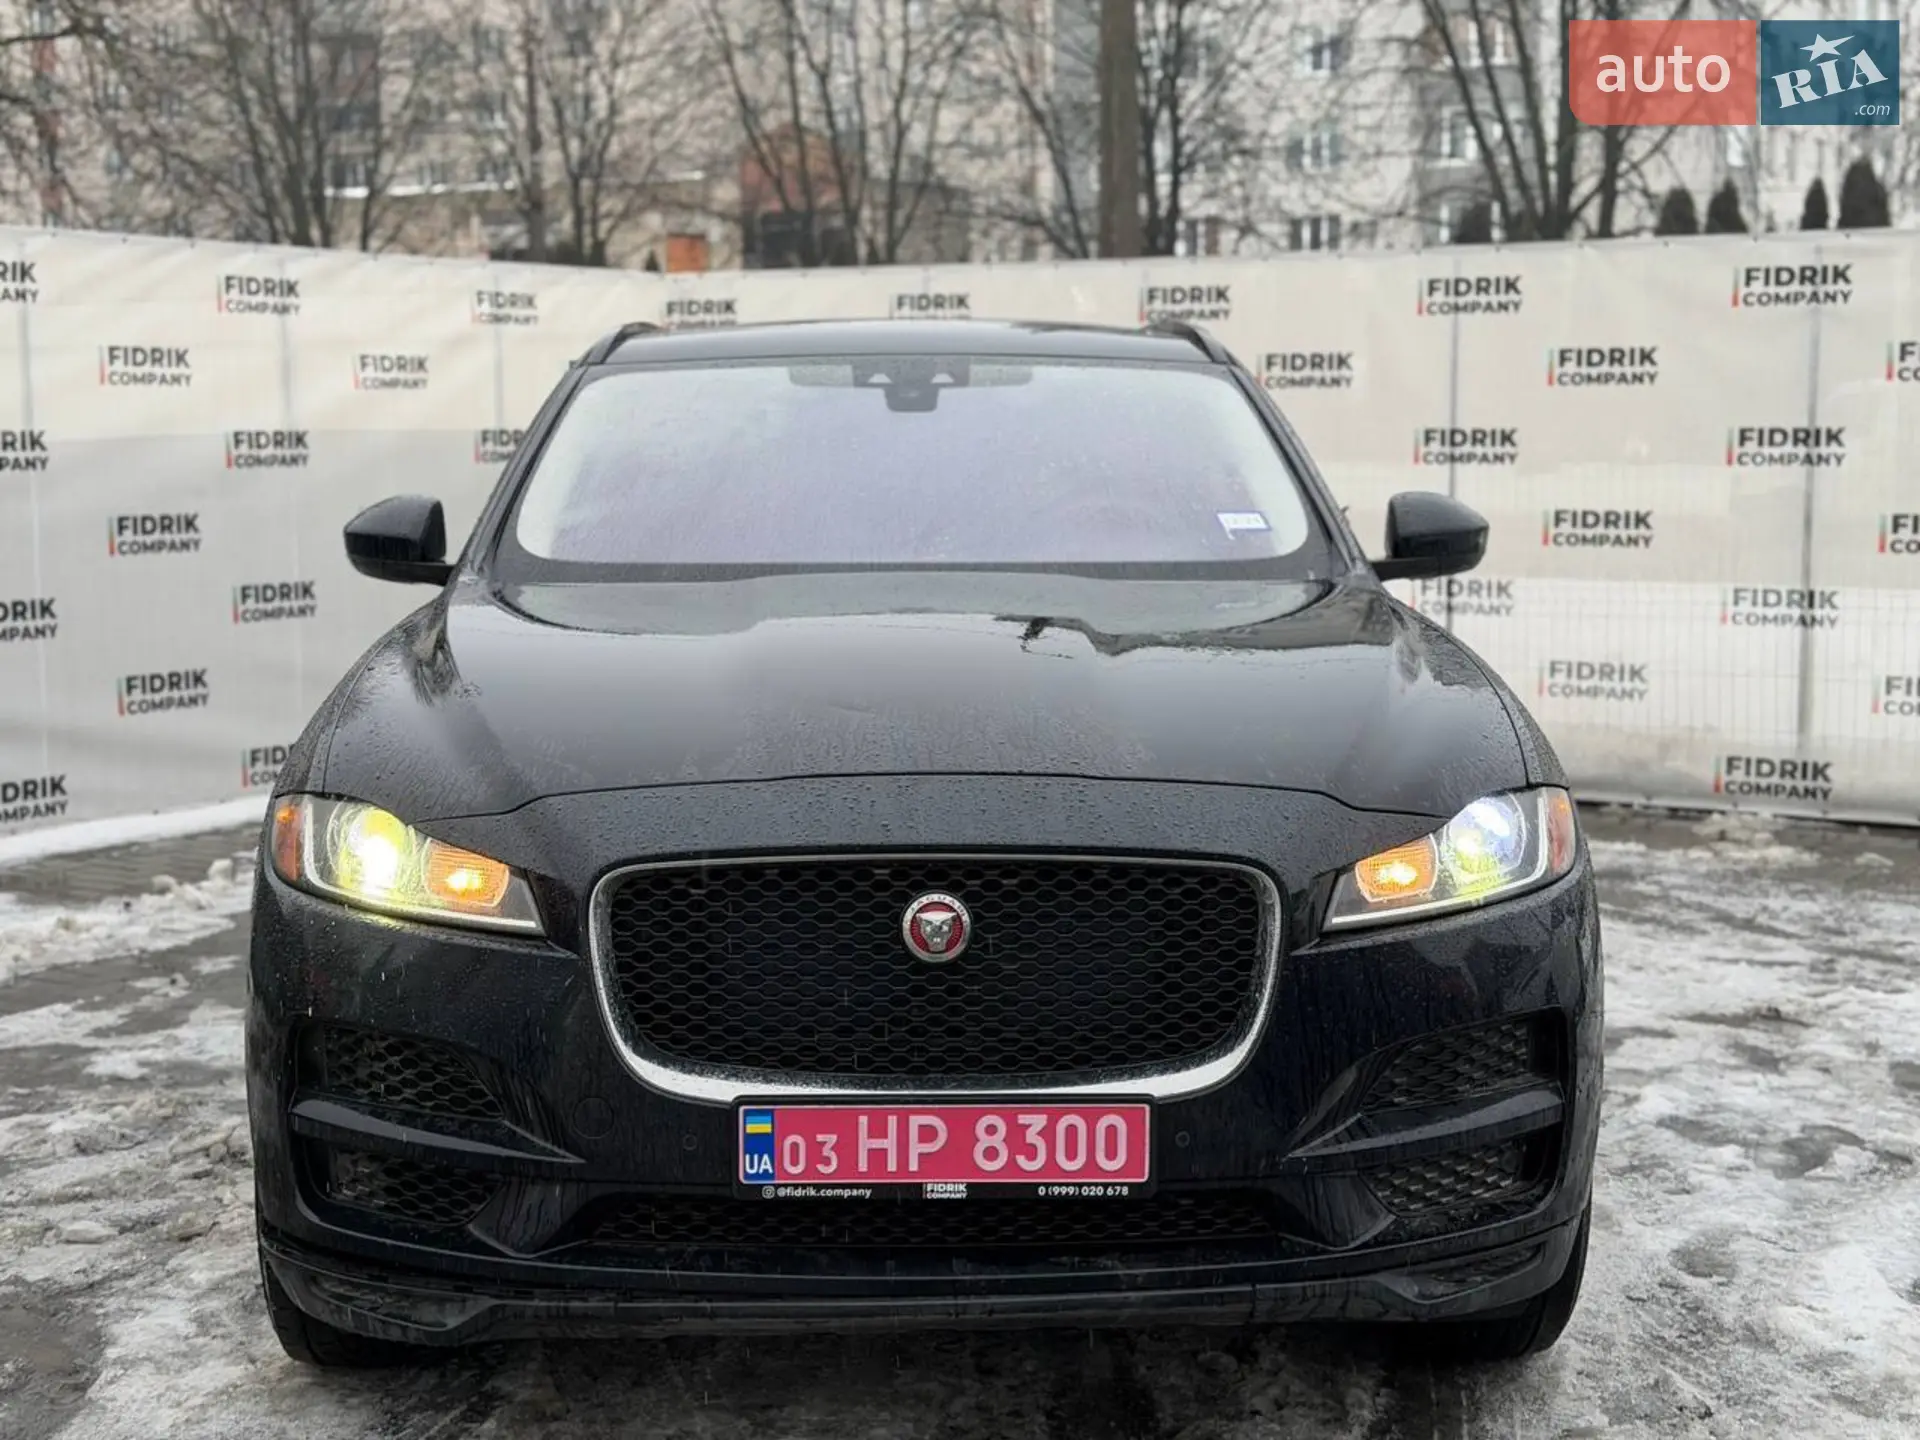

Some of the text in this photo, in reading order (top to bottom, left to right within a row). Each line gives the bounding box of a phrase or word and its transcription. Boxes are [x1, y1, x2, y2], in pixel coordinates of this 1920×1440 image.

[1746, 263, 1852, 287] FIDRIK
[224, 275, 300, 298] FIDRIK
[1147, 286, 1231, 305] FIDRIK
[1427, 276, 1522, 297] FIDRIK
[476, 290, 537, 310] FIDRIK
[667, 299, 737, 317] FIDRIK
[897, 293, 970, 311] FIDRIK
[1427, 300, 1522, 316] COMPANY
[1743, 289, 1852, 307] COMPANY
[225, 301, 301, 317] COMPANY
[479, 312, 538, 325] COMPANY
[107, 345, 190, 368] FIDRIK
[359, 353, 429, 374] FIDRIK
[1264, 353, 1353, 372] FIDRIK
[1558, 347, 1658, 368] FIDRIK
[107, 371, 192, 387] COMPANY
[361, 377, 428, 390] COMPANY
[1265, 375, 1353, 389] COMPANY
[1556, 371, 1658, 386] COMPANY
[232, 430, 309, 451] FIDRIK
[1422, 428, 1518, 449] FIDRIK
[1738, 427, 1846, 449] FIDRIK
[233, 453, 309, 468] COMPANY
[1422, 452, 1518, 466] COMPANY
[1736, 451, 1846, 468] COMPANY
[116, 513, 200, 537] FIDRIK
[1553, 510, 1653, 531] FIDRIK
[117, 538, 201, 556] COMPANY
[1552, 533, 1653, 548] COMPANY
[240, 580, 315, 605] FIDRIK
[1419, 579, 1513, 599] FIDRIK
[1731, 588, 1839, 611] FIDRIK
[241, 603, 317, 623] COMPANY
[1731, 612, 1839, 629] COMPANY
[1547, 660, 1649, 683] FIDRIK
[125, 669, 208, 696] FIDRIK
[1547, 684, 1649, 701] COMPANY
[126, 693, 209, 715] COMPANY
[251, 745, 287, 768] FID
[1724, 755, 1834, 784] FIDRIK
[1724, 780, 1834, 801] COMPANY
[857, 1115, 949, 1172] HP
[973, 1114, 1128, 1172] 8300
[745, 1154, 773, 1174] UA
[777, 1185, 872, 1198] @fidrik.company
[926, 1183, 967, 1192] FIDRIK
[1038, 1185, 1129, 1196] 0 (999) 020 678
